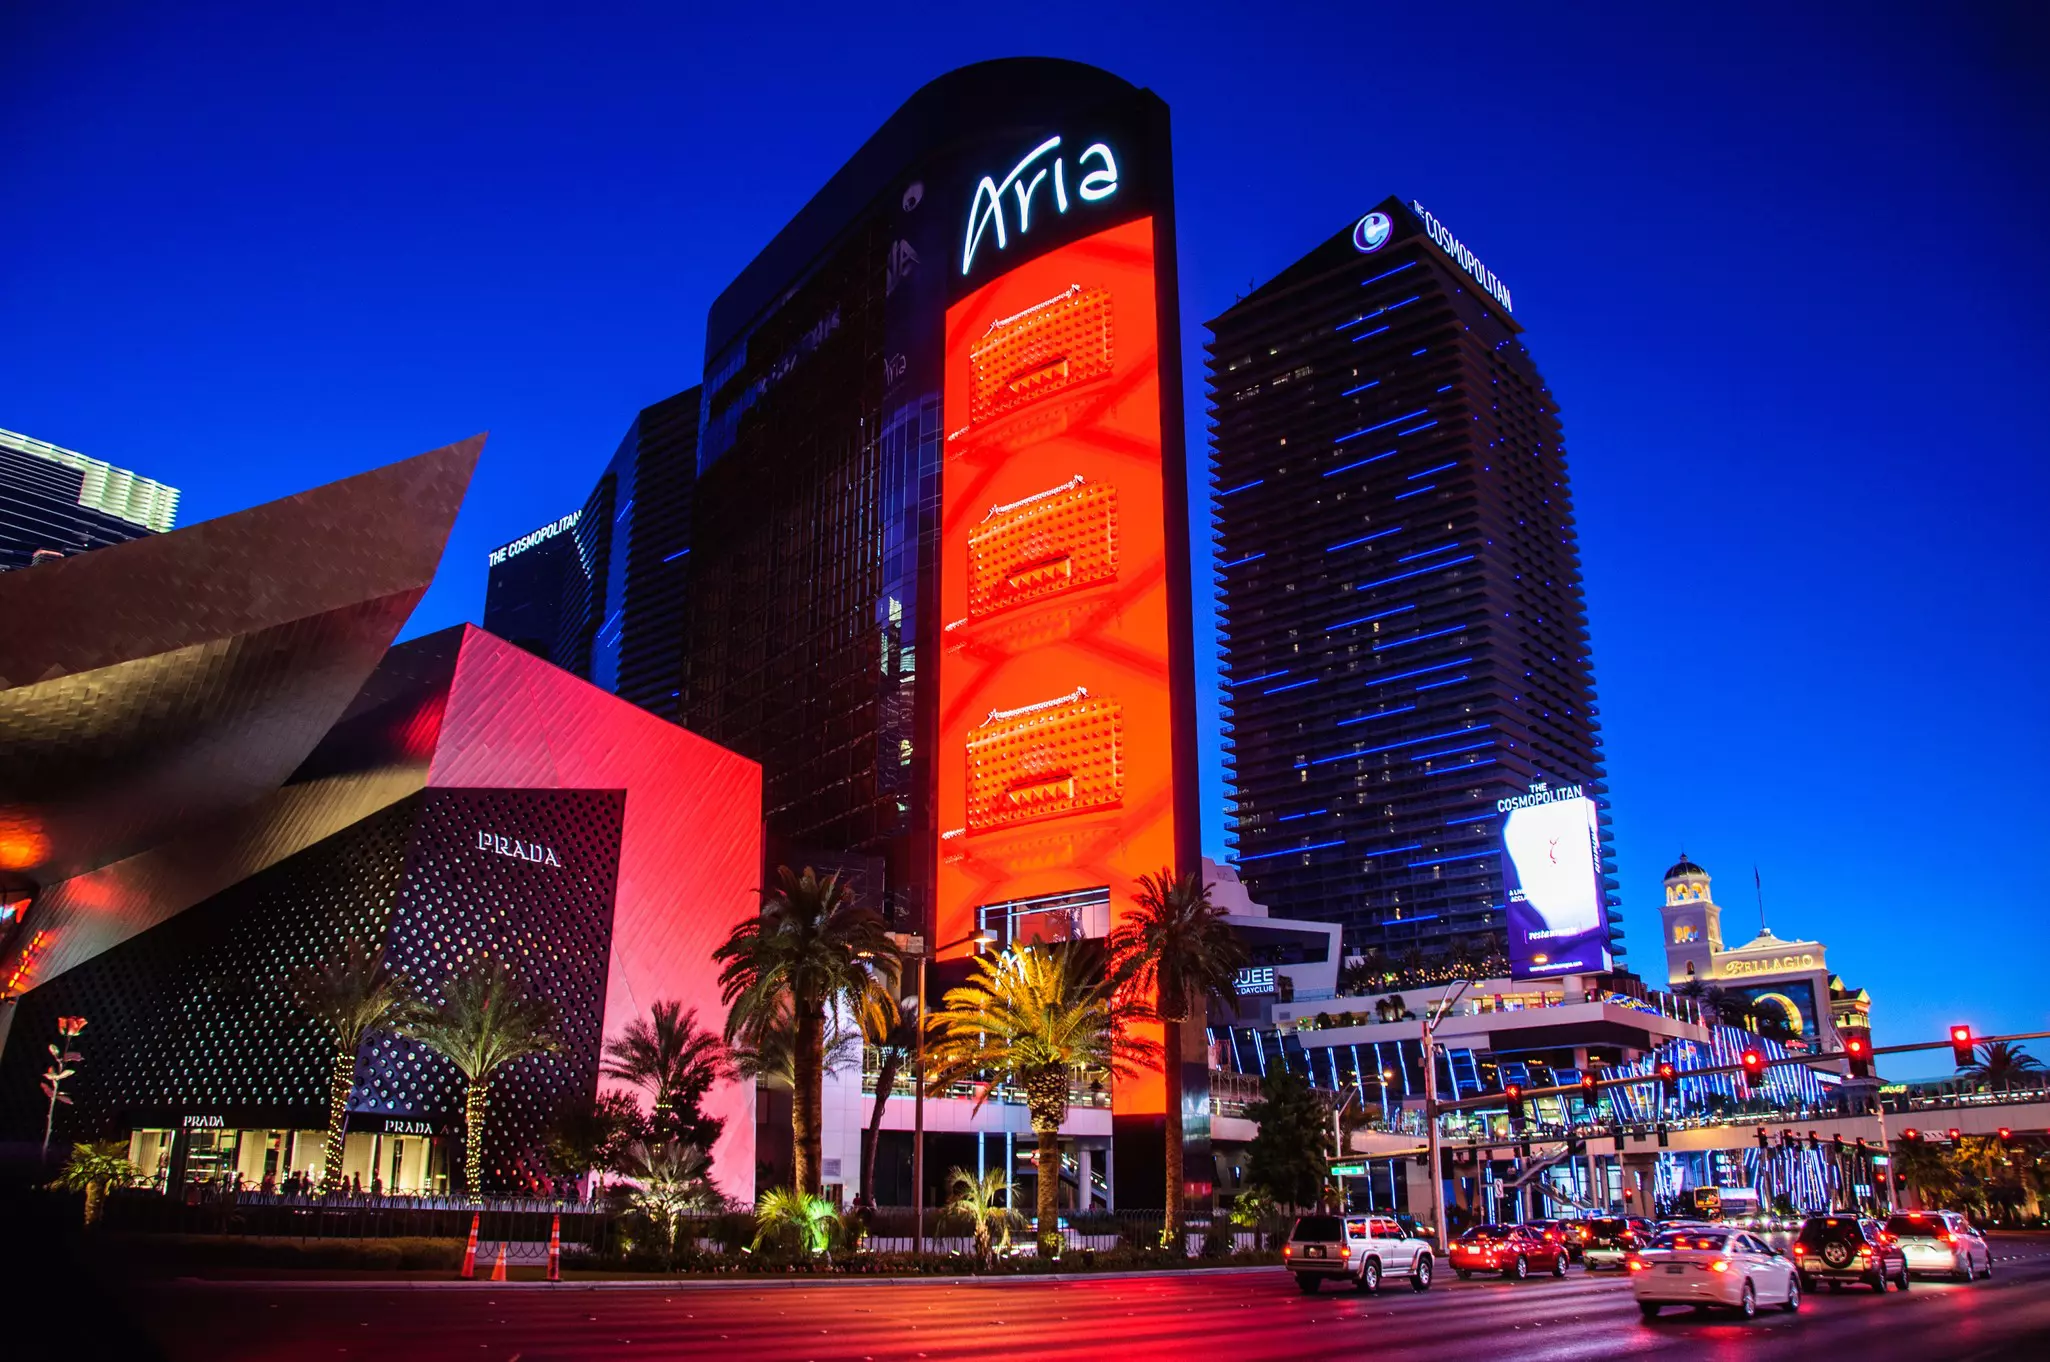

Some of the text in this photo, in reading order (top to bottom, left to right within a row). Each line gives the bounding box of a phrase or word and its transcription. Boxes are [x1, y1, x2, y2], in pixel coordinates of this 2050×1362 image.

[963, 135, 1120, 275] Aria
[1413, 199, 1425, 219] THE
[1425, 211, 1513, 313] COSMOPOLITAN
[488, 547, 508, 567] THE
[1529, 782, 1548, 794] THE
[1497, 784, 1583, 813] COSMOPOLITAN
[476, 829, 562, 868] PRADA
[1725, 954, 1814, 975] BELLAGIO
[1240, 985, 1275, 995] DAYCLUB
[183, 1115, 225, 1127] PRADA
[384, 1119, 433, 1135] PRADA
